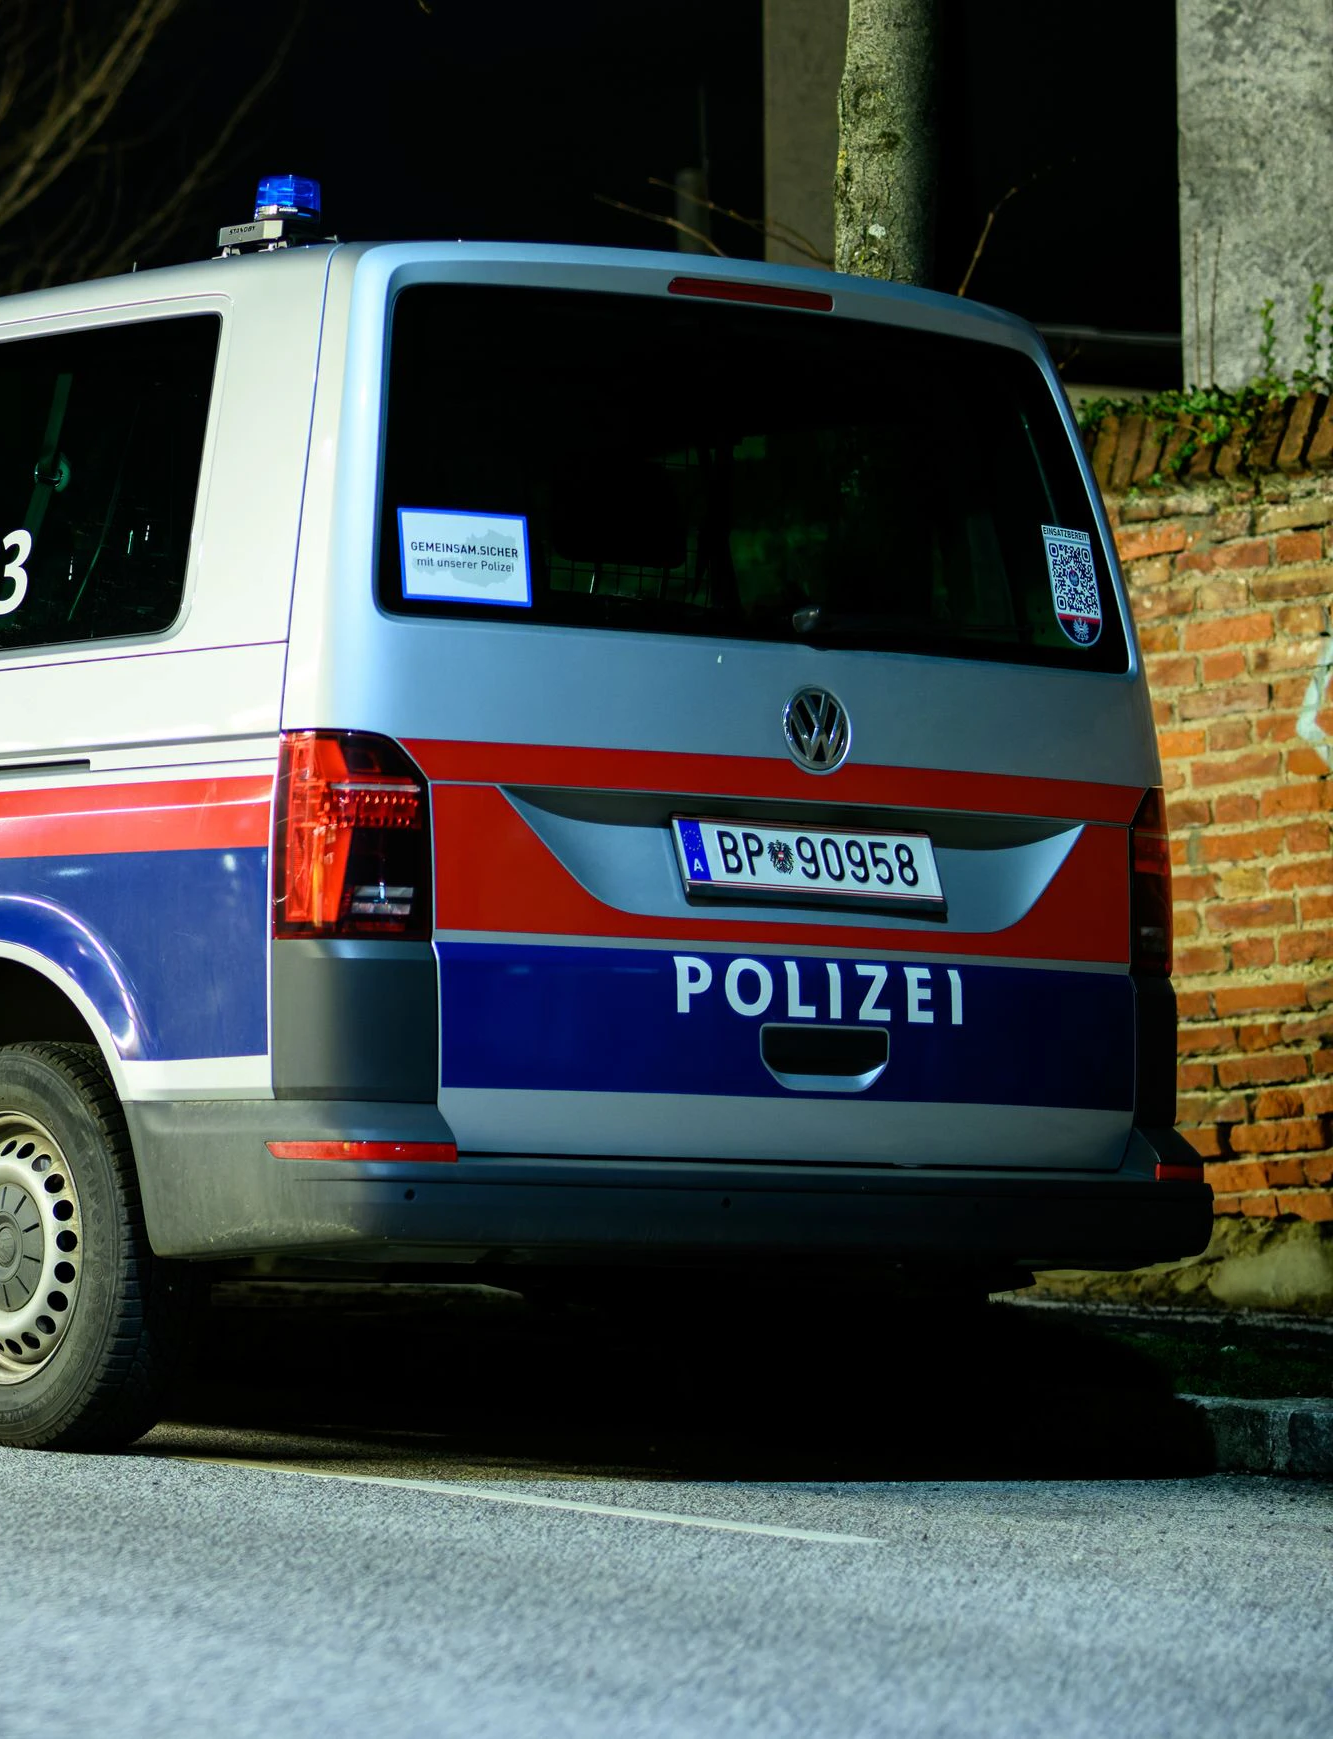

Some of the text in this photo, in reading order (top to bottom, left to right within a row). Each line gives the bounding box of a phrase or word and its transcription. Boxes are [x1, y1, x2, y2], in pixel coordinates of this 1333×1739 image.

[229, 225, 256, 236] STANDBY
[1043, 527, 1089, 541] EINSATZBEREIT!
[411, 542, 518, 558] GEMEINSAM.SICHER
[417, 557, 515, 572] mit unserer Polizei
[693, 830, 919, 887] A BP 90958
[673, 955, 963, 1025] POLIZEI
